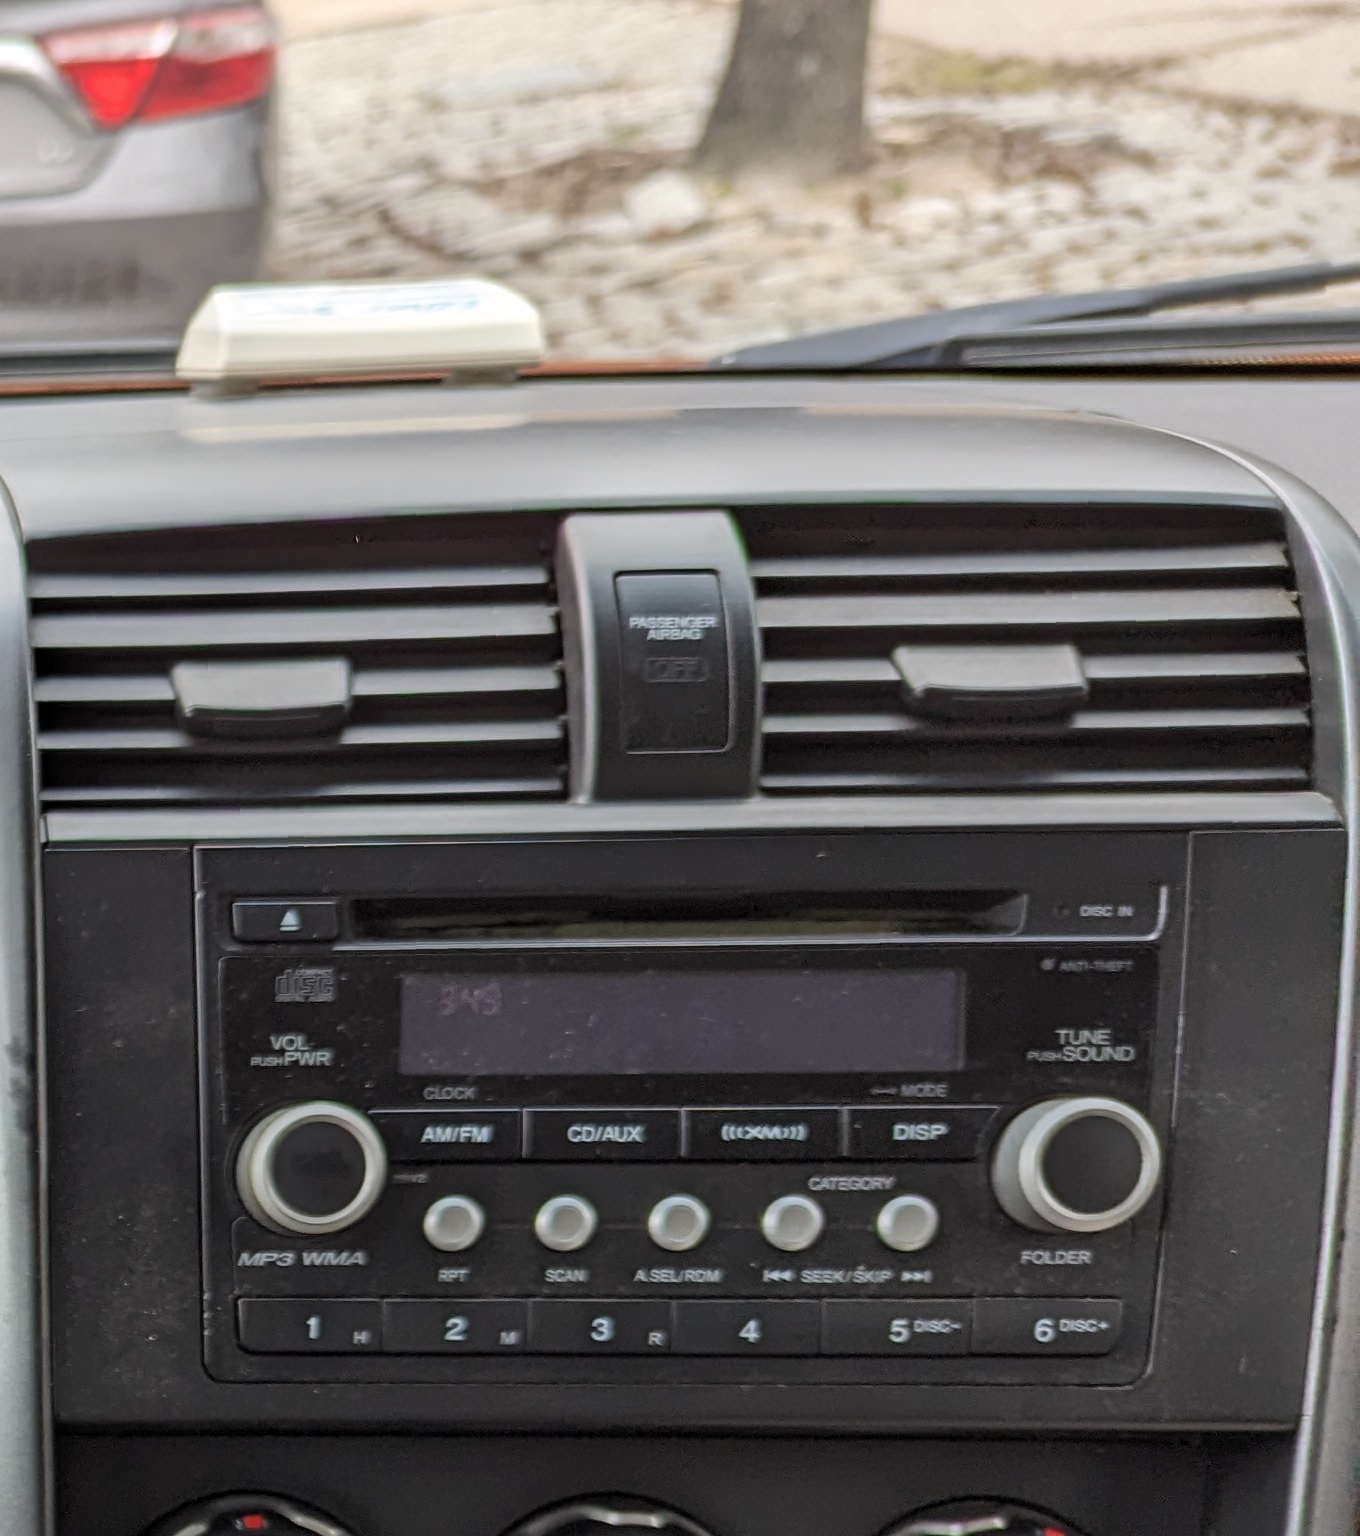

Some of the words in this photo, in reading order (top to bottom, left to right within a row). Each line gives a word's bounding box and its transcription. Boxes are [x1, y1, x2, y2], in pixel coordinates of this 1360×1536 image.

[629, 616, 717, 629] PASSENGER
[647, 629, 703, 641] AIRBAG
[270, 1035, 309, 1050] VOL
[1055, 1029, 1111, 1045] TUNE
[250, 1056, 283, 1067] PUSH
[283, 1051, 331, 1066] PWR
[1062, 1046, 1135, 1062] SOUND
[424, 1086, 475, 1099] CLOCK
[901, 1083, 949, 1098] MODE
[421, 1125, 493, 1144] AM/FM
[567, 1125, 643, 1143] CD/AUX
[892, 1123, 949, 1141] DISP
[807, 1176, 895, 1191] CATEGORY
[237, 1251, 295, 1267] MP3
[300, 1251, 366, 1267] WMA
[1020, 1250, 1092, 1266] FOLDER
[437, 1268, 468, 1282] RPT
[543, 1268, 589, 1283] SCAN
[306, 1316, 322, 1340] 1
[444, 1316, 468, 1341] 2
[500, 1331, 520, 1345] M
[591, 1317, 615, 1342] 3
[647, 1331, 665, 1346] R
[738, 1318, 762, 1343] 4
[888, 1318, 910, 1343] 5
[1033, 1318, 1056, 1343] 6
